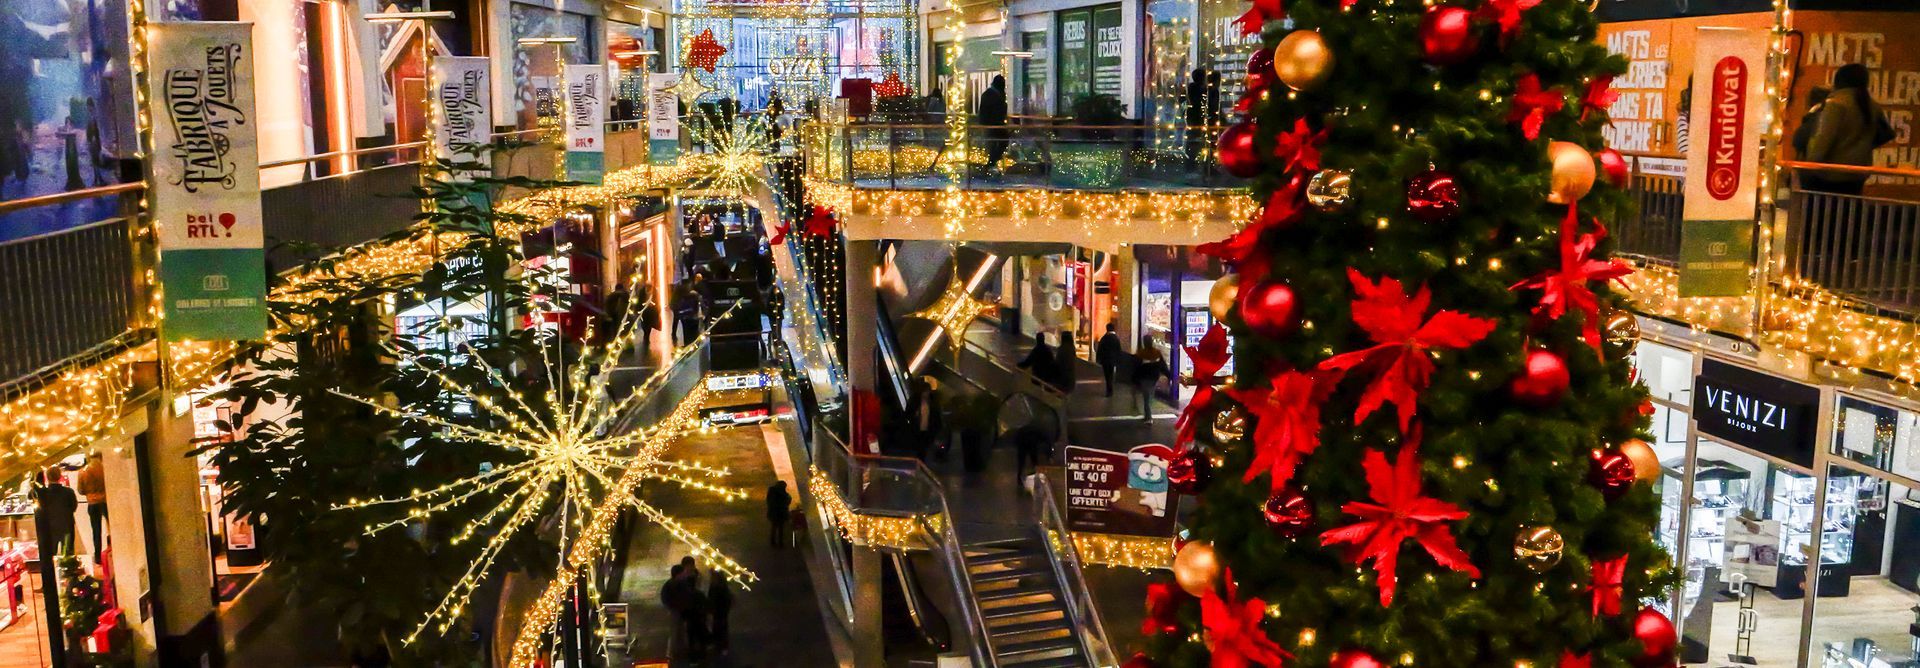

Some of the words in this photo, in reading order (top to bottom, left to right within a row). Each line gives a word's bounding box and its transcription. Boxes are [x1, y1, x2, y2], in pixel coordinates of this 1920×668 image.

[1607, 30, 1650, 59] METS
[1806, 32, 1885, 68] METS
[204, 46, 245, 126] JOUETS
[1609, 60, 1667, 89] ALERIES
[1608, 92, 1640, 119] ANS
[1645, 92, 1663, 120] TA
[1715, 65, 1741, 165] Kruidvat
[171, 69, 233, 194] FABRIQUE
[187, 213, 213, 223] bel
[187, 224, 219, 238] RTL
[1706, 385, 1786, 430] VENIZI
[1727, 418, 1757, 433] BIJOUX
[1074, 472, 1085, 481] DE
[1087, 472, 1099, 482] 40
[1072, 497, 1104, 506] OFFERTE
